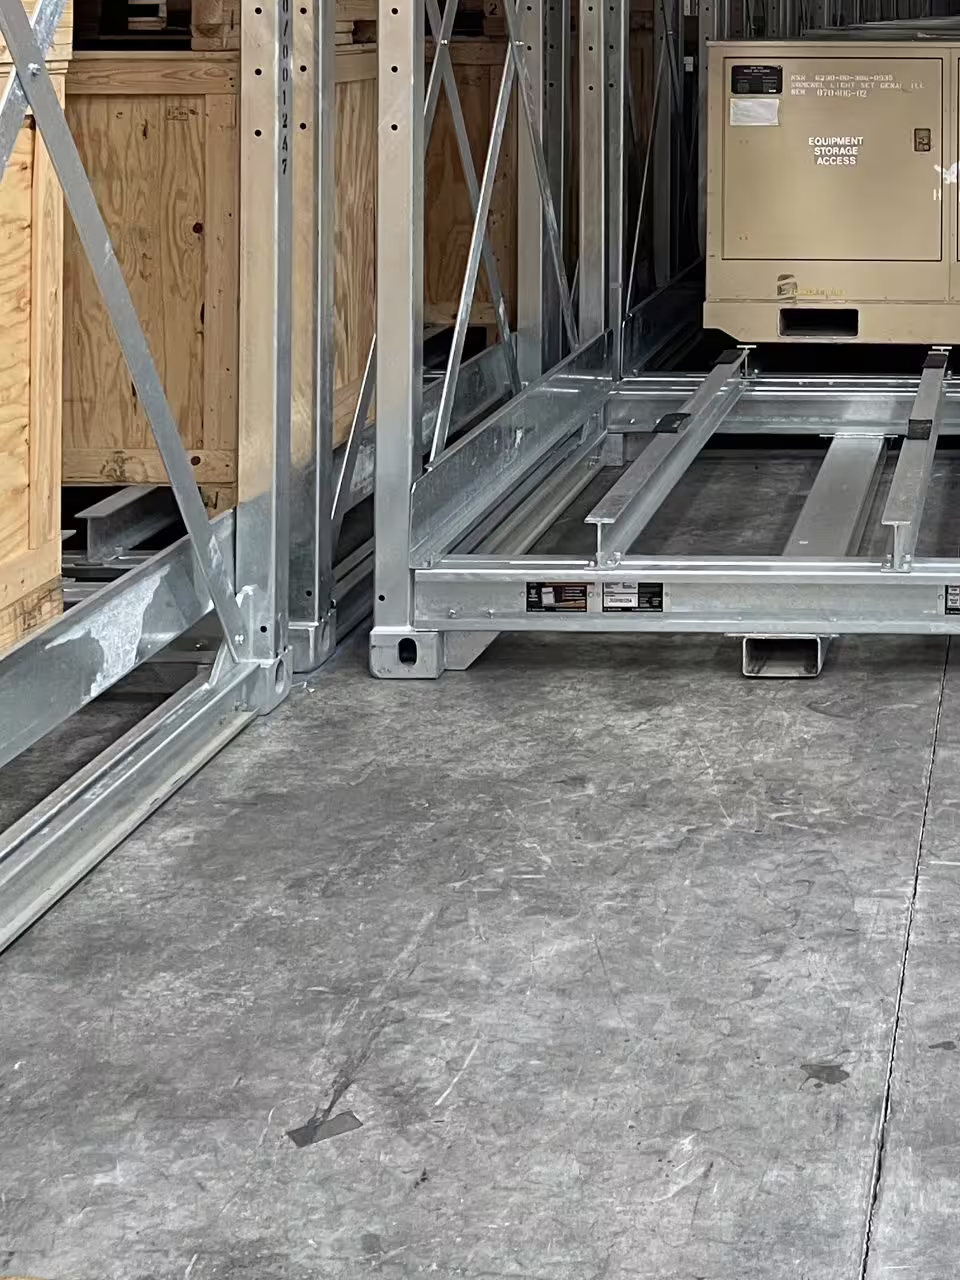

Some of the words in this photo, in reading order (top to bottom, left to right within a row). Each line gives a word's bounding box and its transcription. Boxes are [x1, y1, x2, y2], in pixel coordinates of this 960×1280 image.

[489, 2, 498, 16] 2
[808, 136, 864, 146] EQUIPMENT
[814, 146, 859, 155] STORAGE
[816, 156, 857, 165] ACCESS
